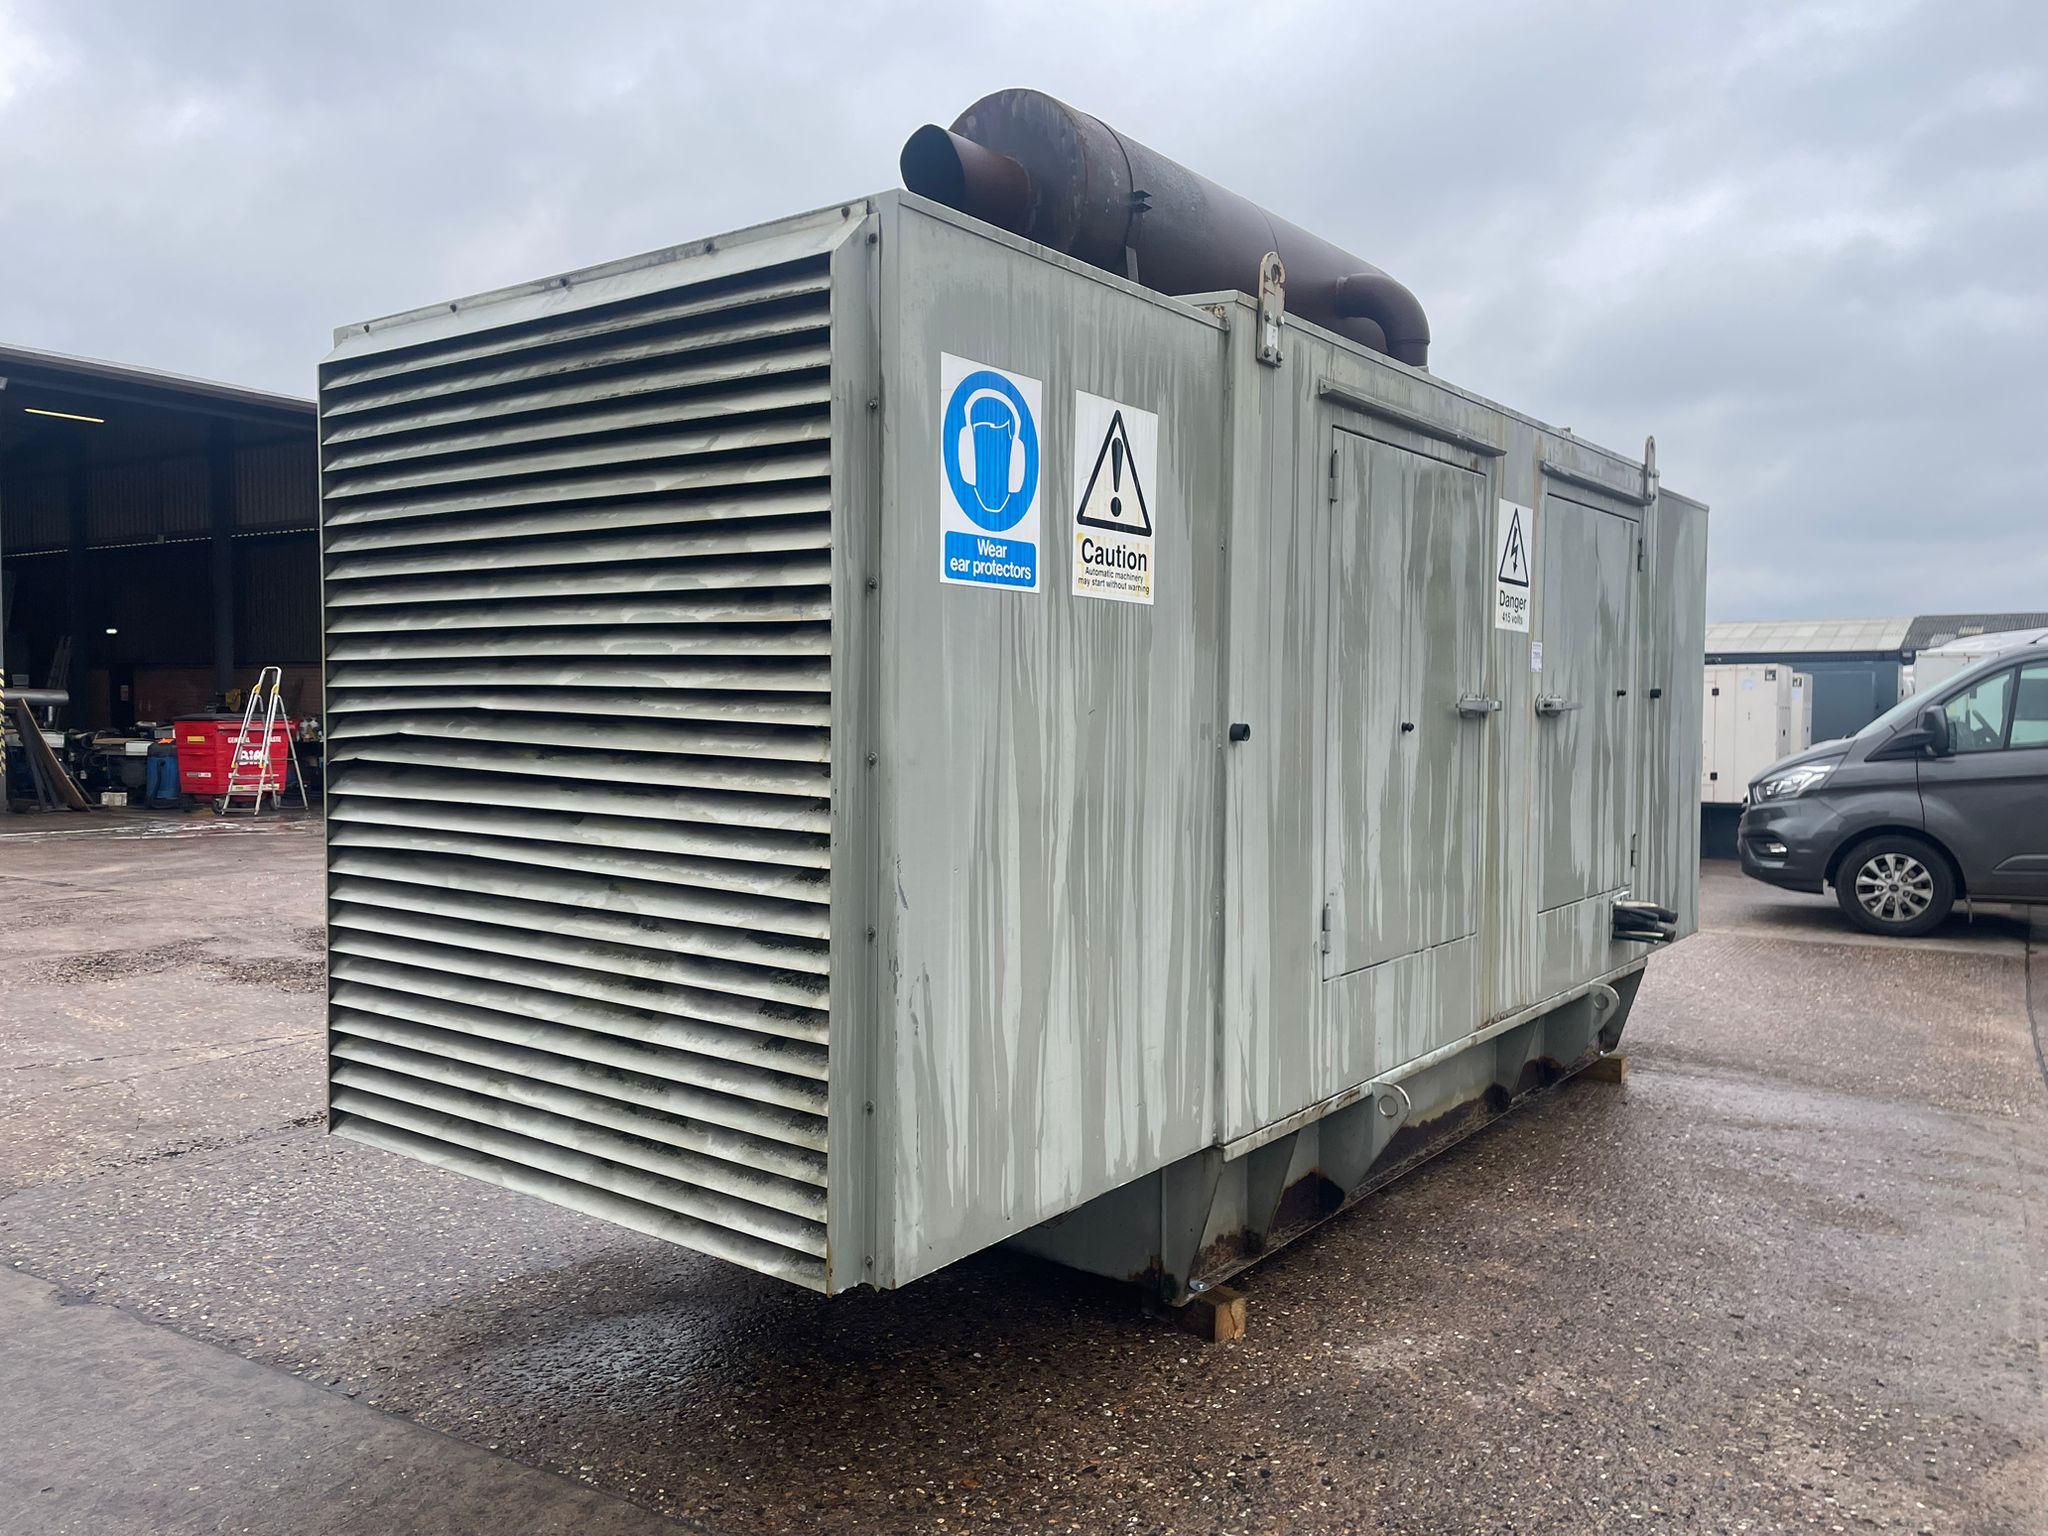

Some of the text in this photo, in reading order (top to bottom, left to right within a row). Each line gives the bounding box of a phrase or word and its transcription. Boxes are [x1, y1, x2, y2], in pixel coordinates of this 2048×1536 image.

[977, 538, 1008, 558] Wear
[1082, 538, 1147, 572] Caution
[950, 557, 1032, 580] ear protectors
[1085, 566, 1144, 584] Automatic machinery
[1078, 577, 1150, 596] may start without warning
[1500, 589, 1527, 613] Danger
[1502, 611, 1524, 625] 415 volts
